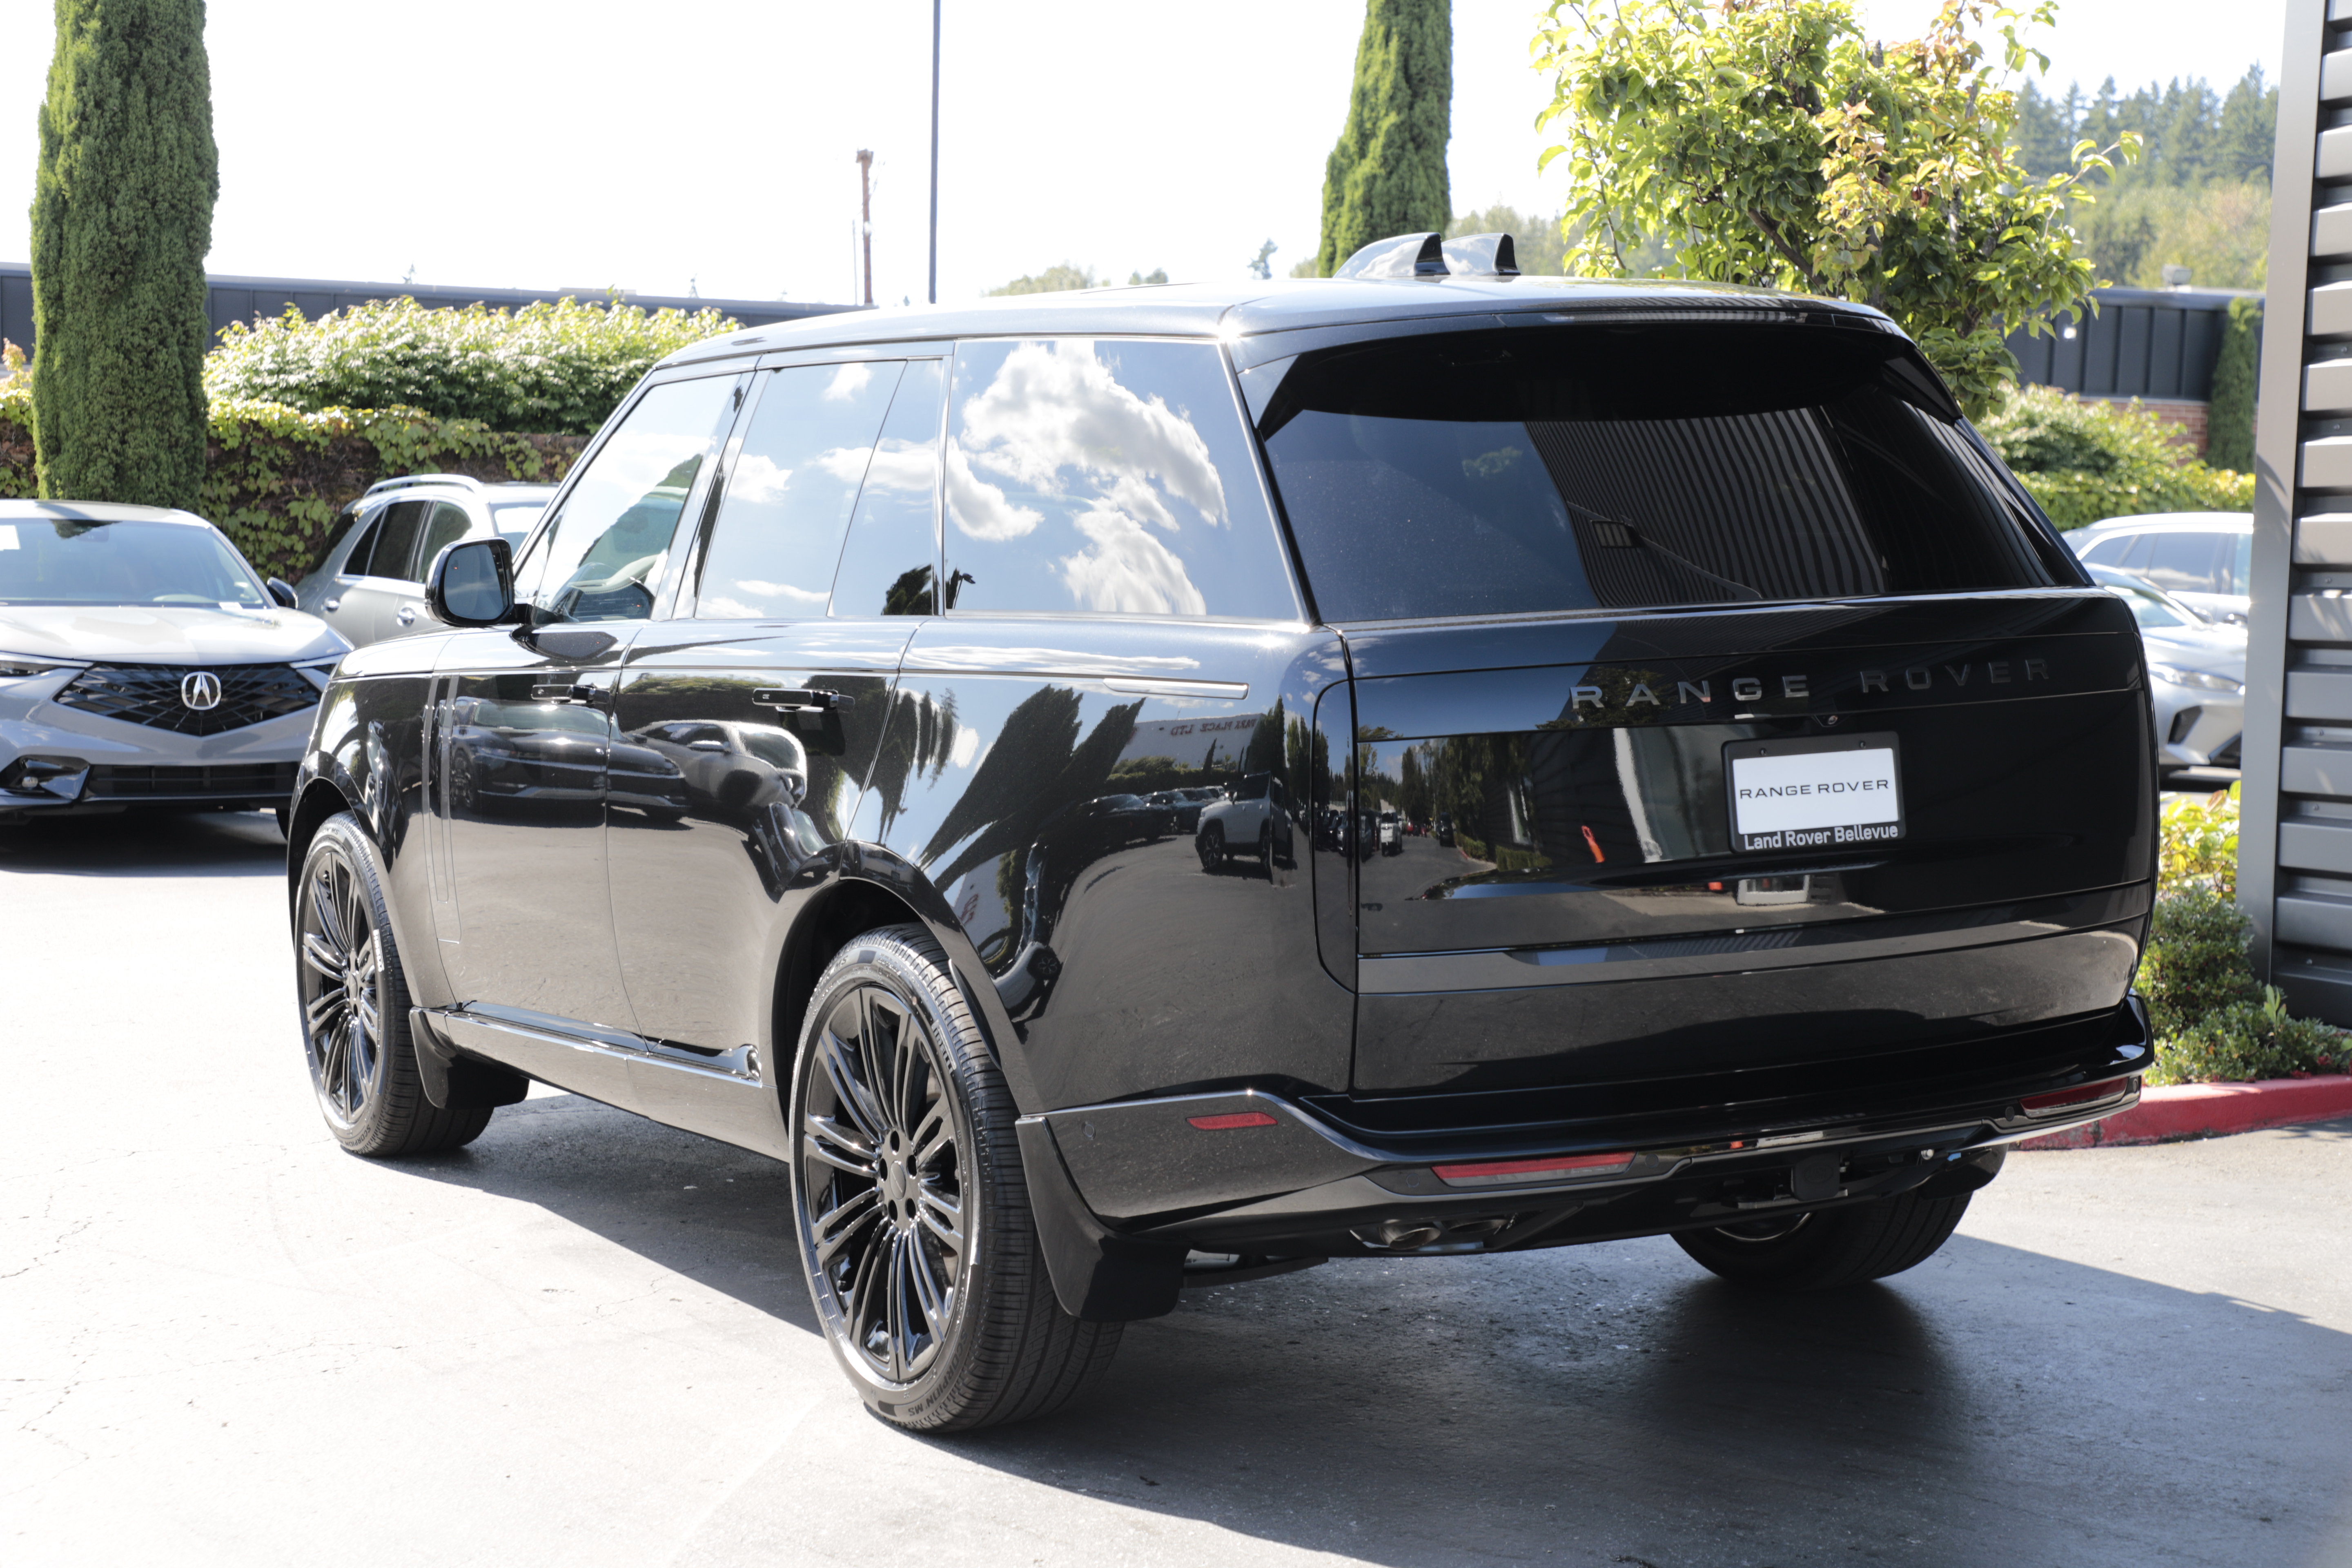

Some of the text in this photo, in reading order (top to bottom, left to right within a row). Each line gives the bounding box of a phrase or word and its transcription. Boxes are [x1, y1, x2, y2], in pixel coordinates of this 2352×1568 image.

[1570, 659, 2049, 709] RANGE ROVER
[1740, 780, 1889, 799] RANGE ROVER
[1744, 824, 1898, 850] Land Rover Bellevue
[345, 1124, 371, 1147] SCORPION
[926, 1328, 968, 1407] SCORPION
[908, 1403, 924, 1416] MS
